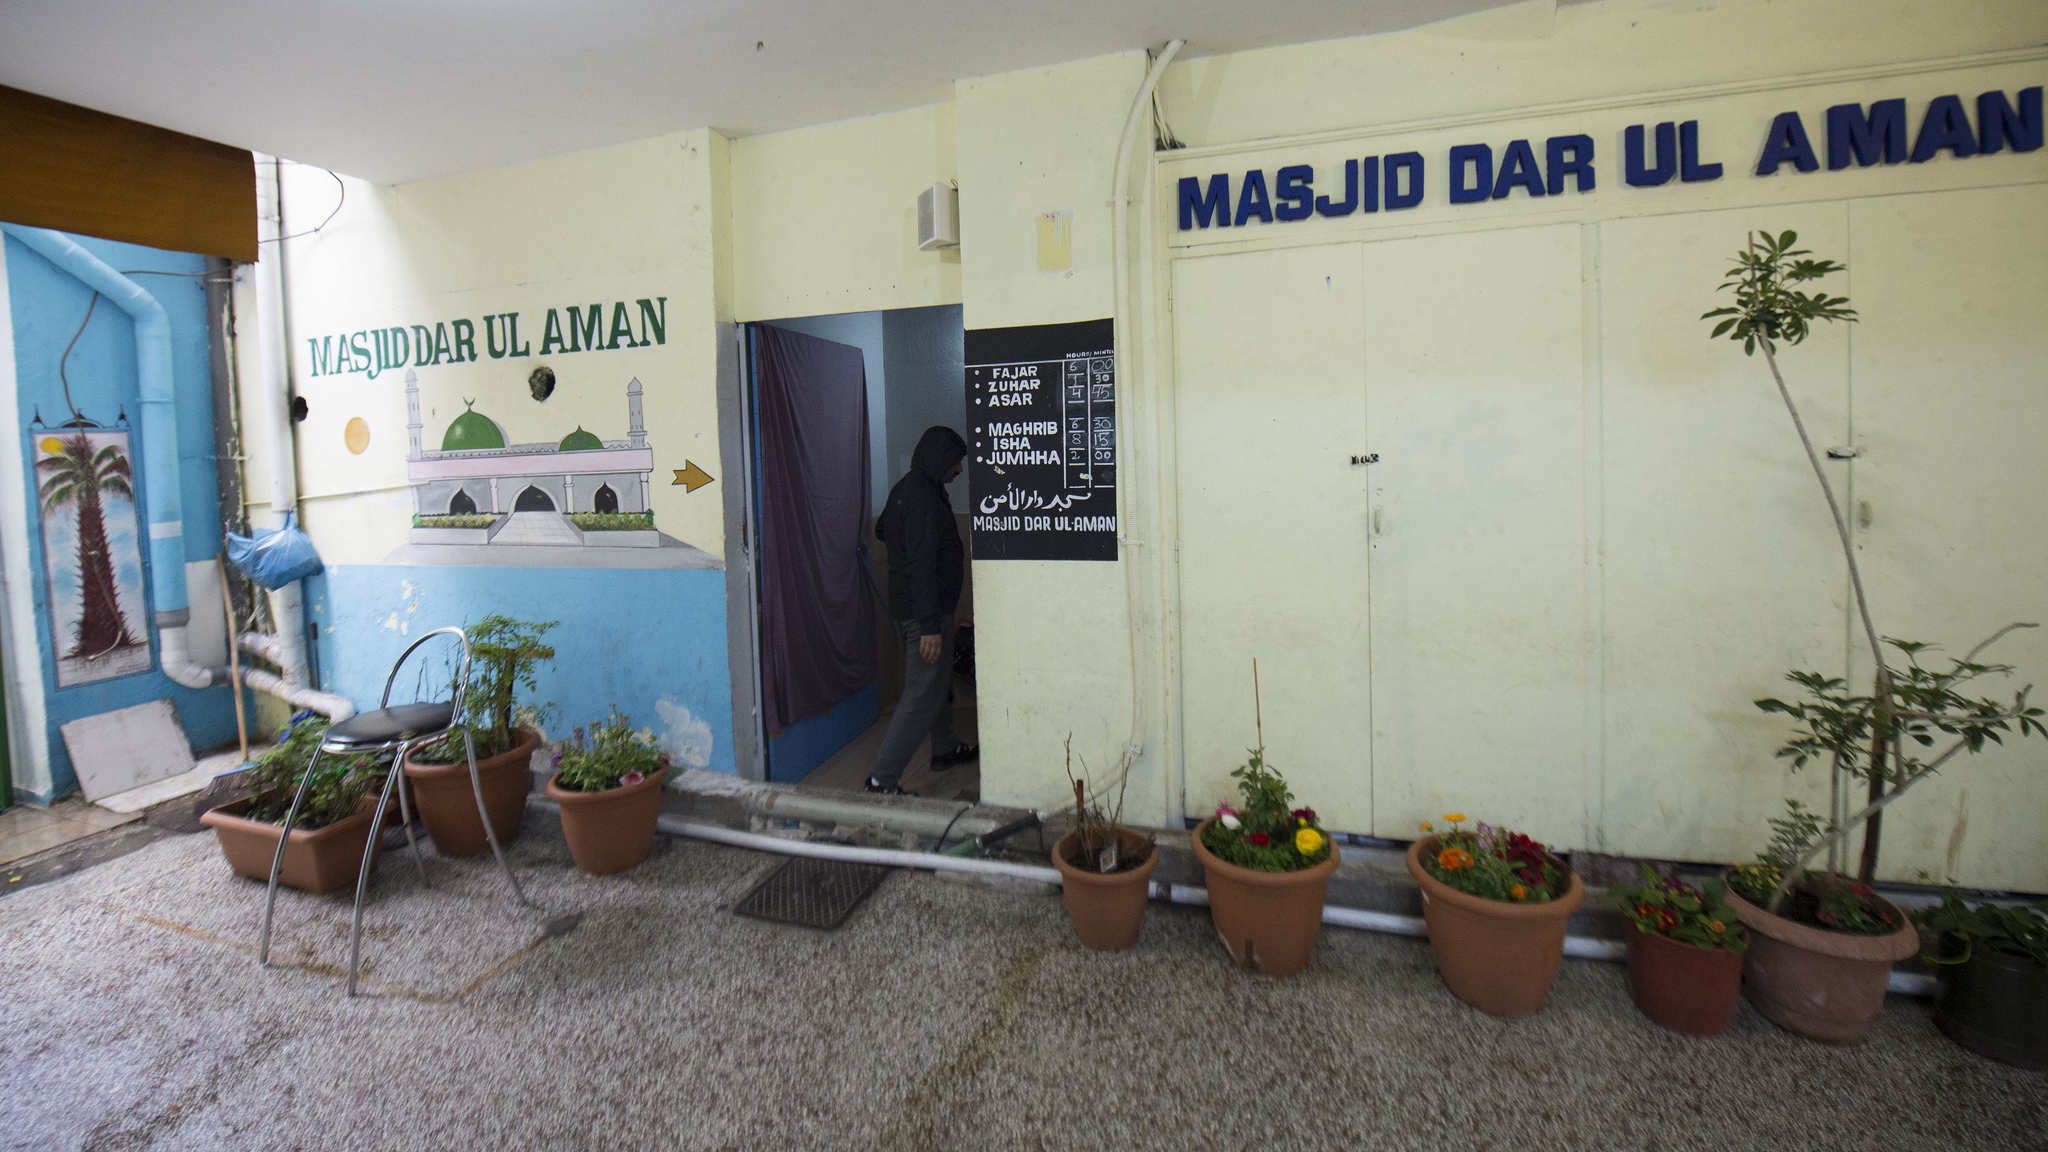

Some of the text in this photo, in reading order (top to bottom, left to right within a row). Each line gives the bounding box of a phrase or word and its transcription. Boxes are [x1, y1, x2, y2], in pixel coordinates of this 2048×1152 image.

[1178, 86, 2046, 231] MASJID DAR UL AMAN
[307, 297, 667, 380] MASJID DAR UL AMAN
[993, 358, 1114, 380] FAJAR 6 00
[988, 379, 1041, 393] ZUHAR
[1095, 374, 1110, 384] 30
[988, 385, 1110, 408] ASAR 4 45
[988, 418, 1112, 437] MAGHRIB 6 30
[993, 432, 1110, 451] ISHA 8 15
[985, 450, 1111, 465] JUMHHA 2 00
[973, 515, 1020, 532] MASJID
[1024, 515, 1051, 532] DAR
